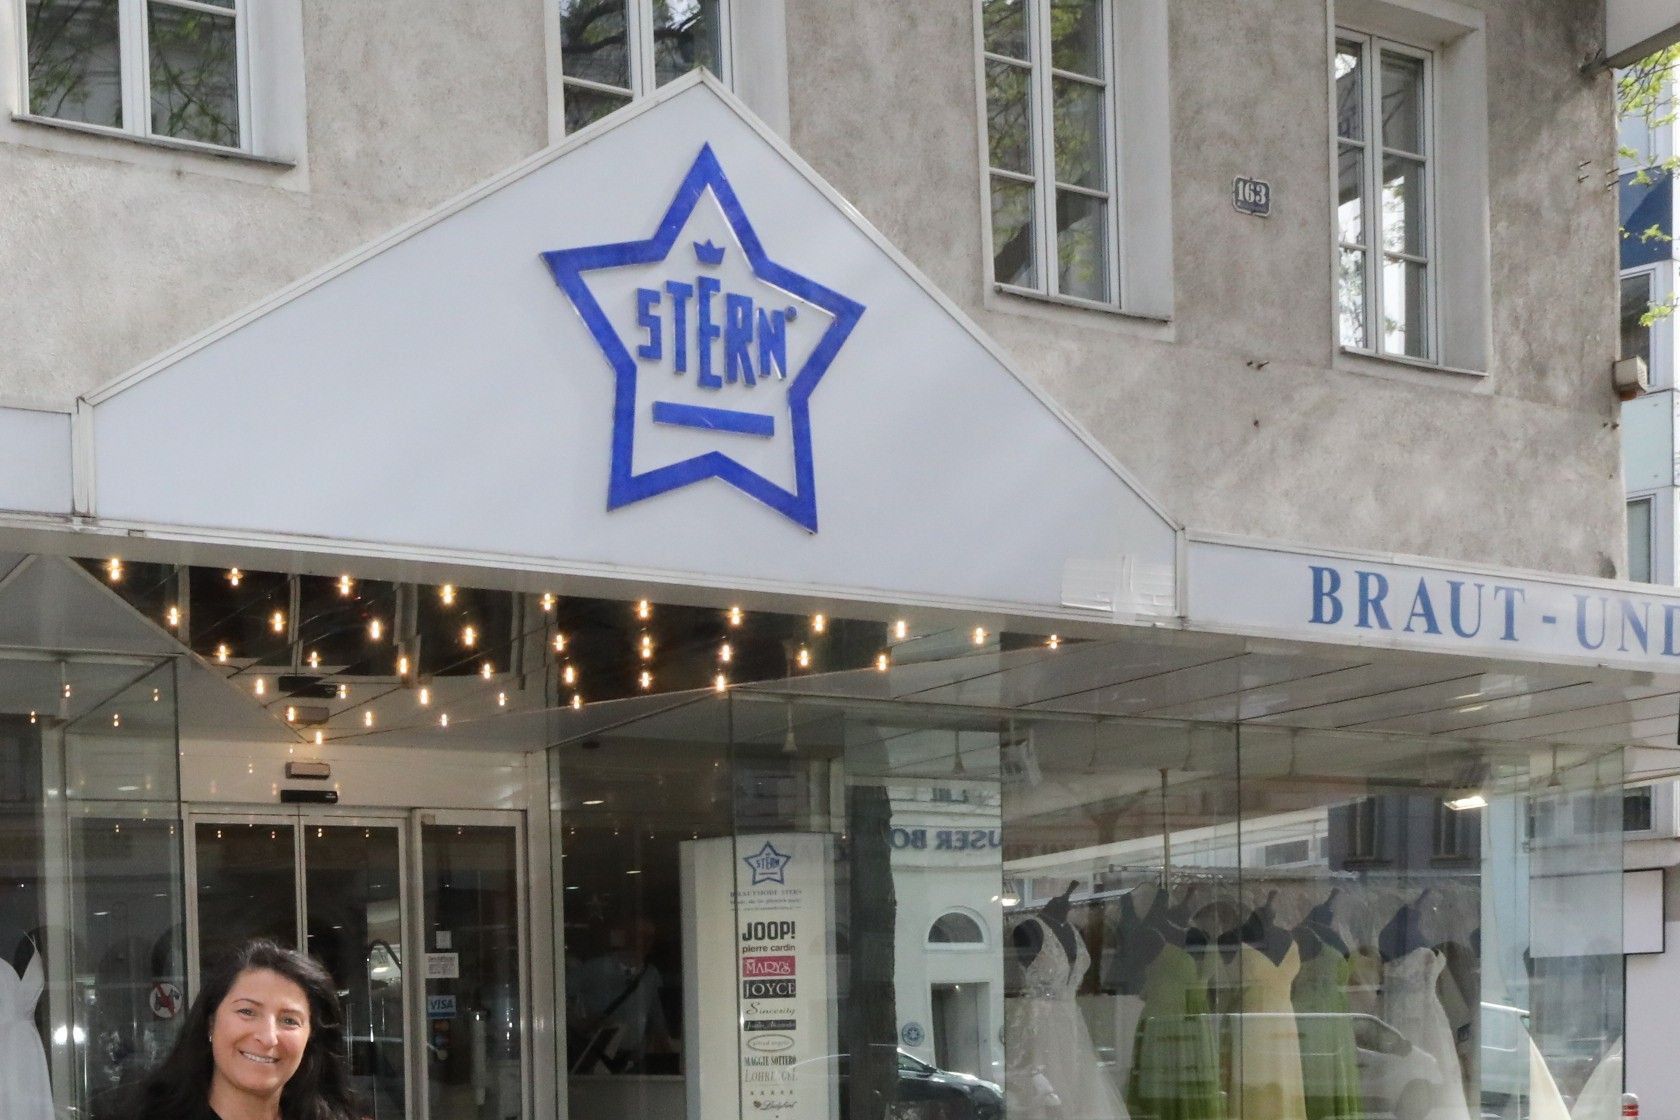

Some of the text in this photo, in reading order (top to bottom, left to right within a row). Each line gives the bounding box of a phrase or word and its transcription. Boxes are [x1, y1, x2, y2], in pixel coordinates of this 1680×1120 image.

[1237, 181, 1266, 205] 163
[636, 276, 788, 389] STERN
[742, 921, 796, 941] JOOP!
[742, 943, 796, 954] pierre cardin
[745, 982, 796, 999] JOYCE
[431, 999, 454, 1010] VISA
